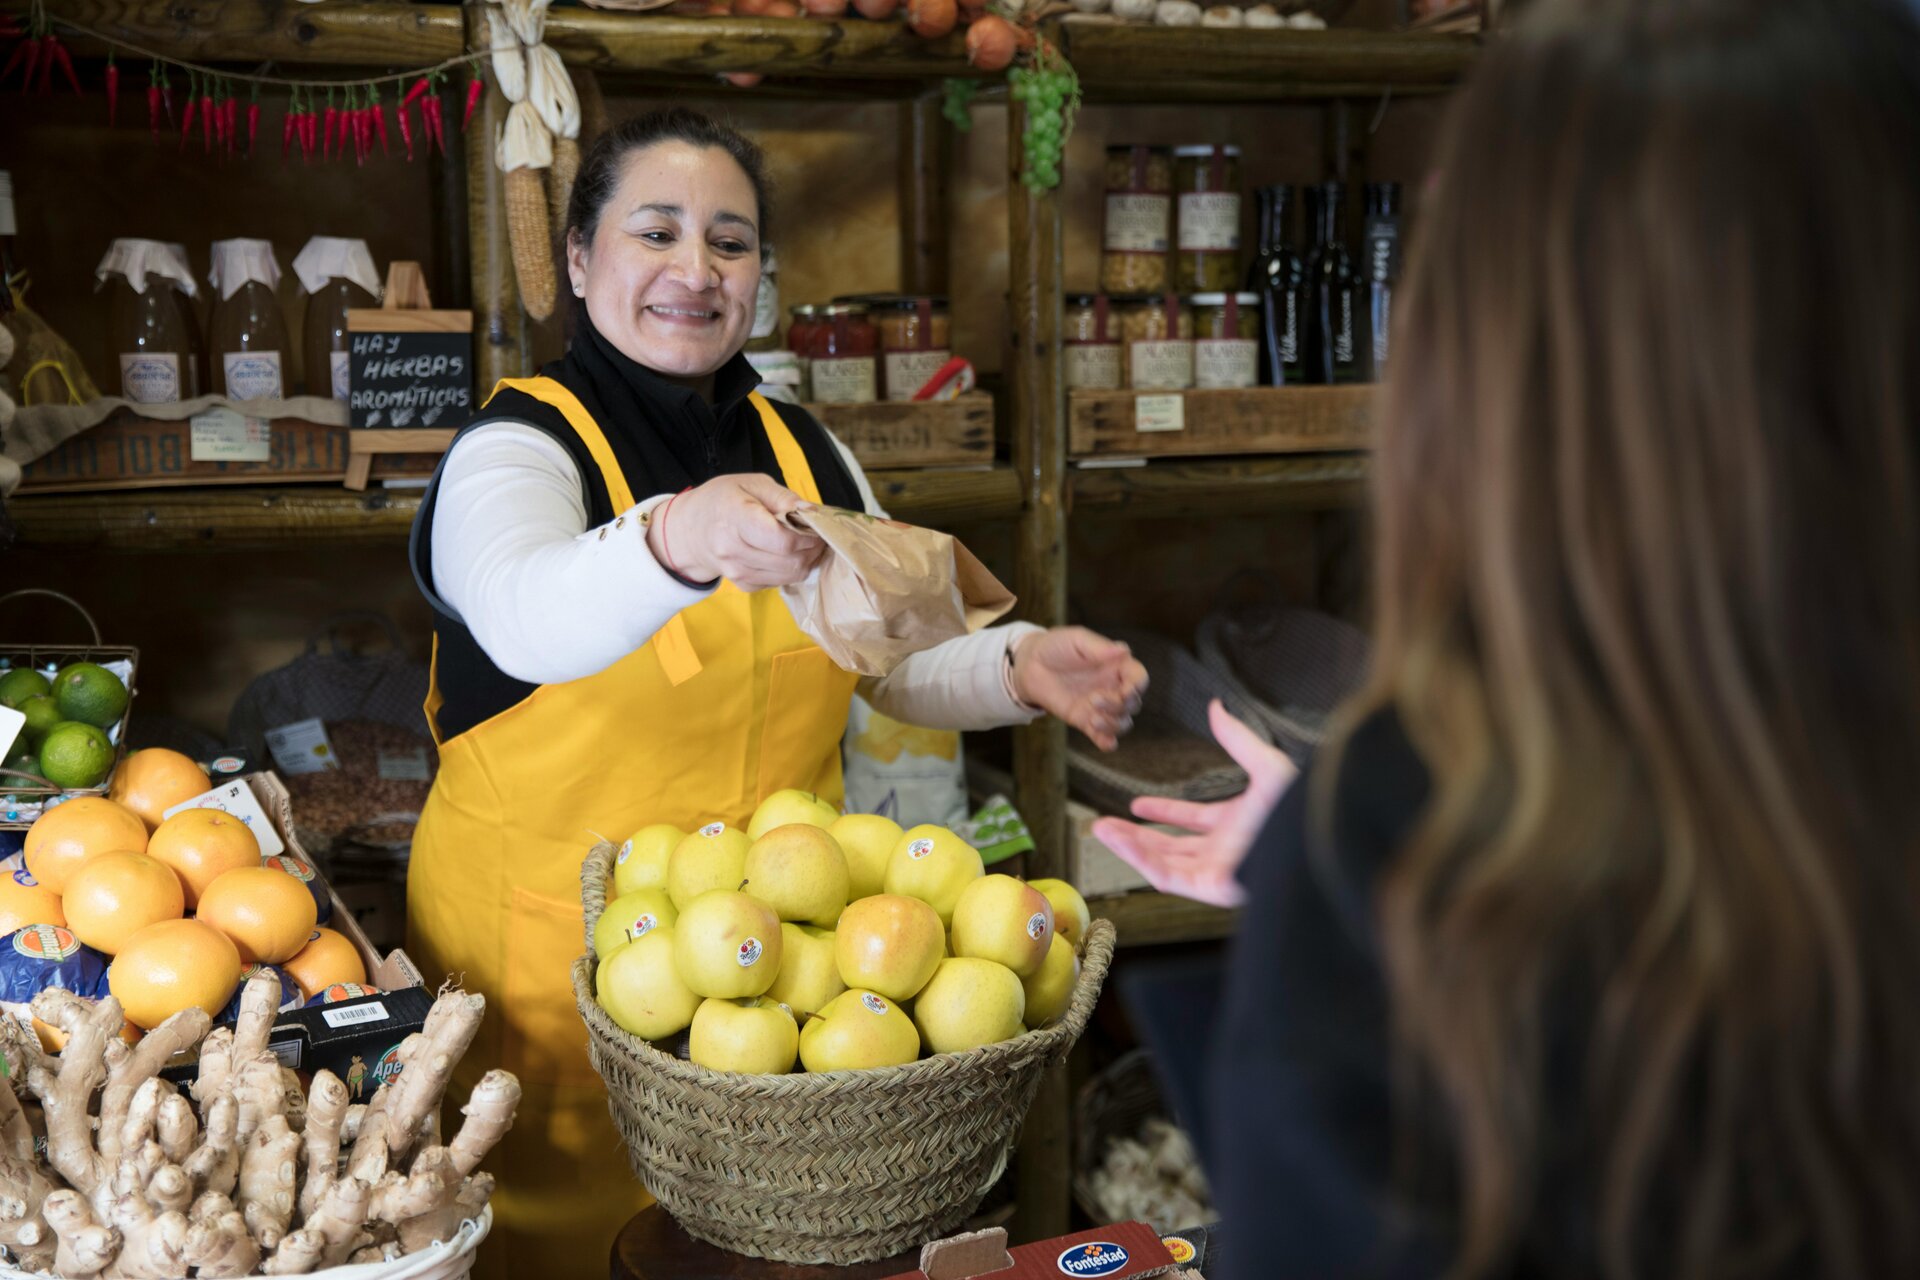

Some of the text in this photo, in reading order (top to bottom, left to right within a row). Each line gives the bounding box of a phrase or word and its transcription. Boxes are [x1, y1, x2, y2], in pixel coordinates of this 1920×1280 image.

[353, 334, 401, 355] HAY
[372, 1060, 403, 1080] Ape
[1065, 1247, 1127, 1273] Fontestad
